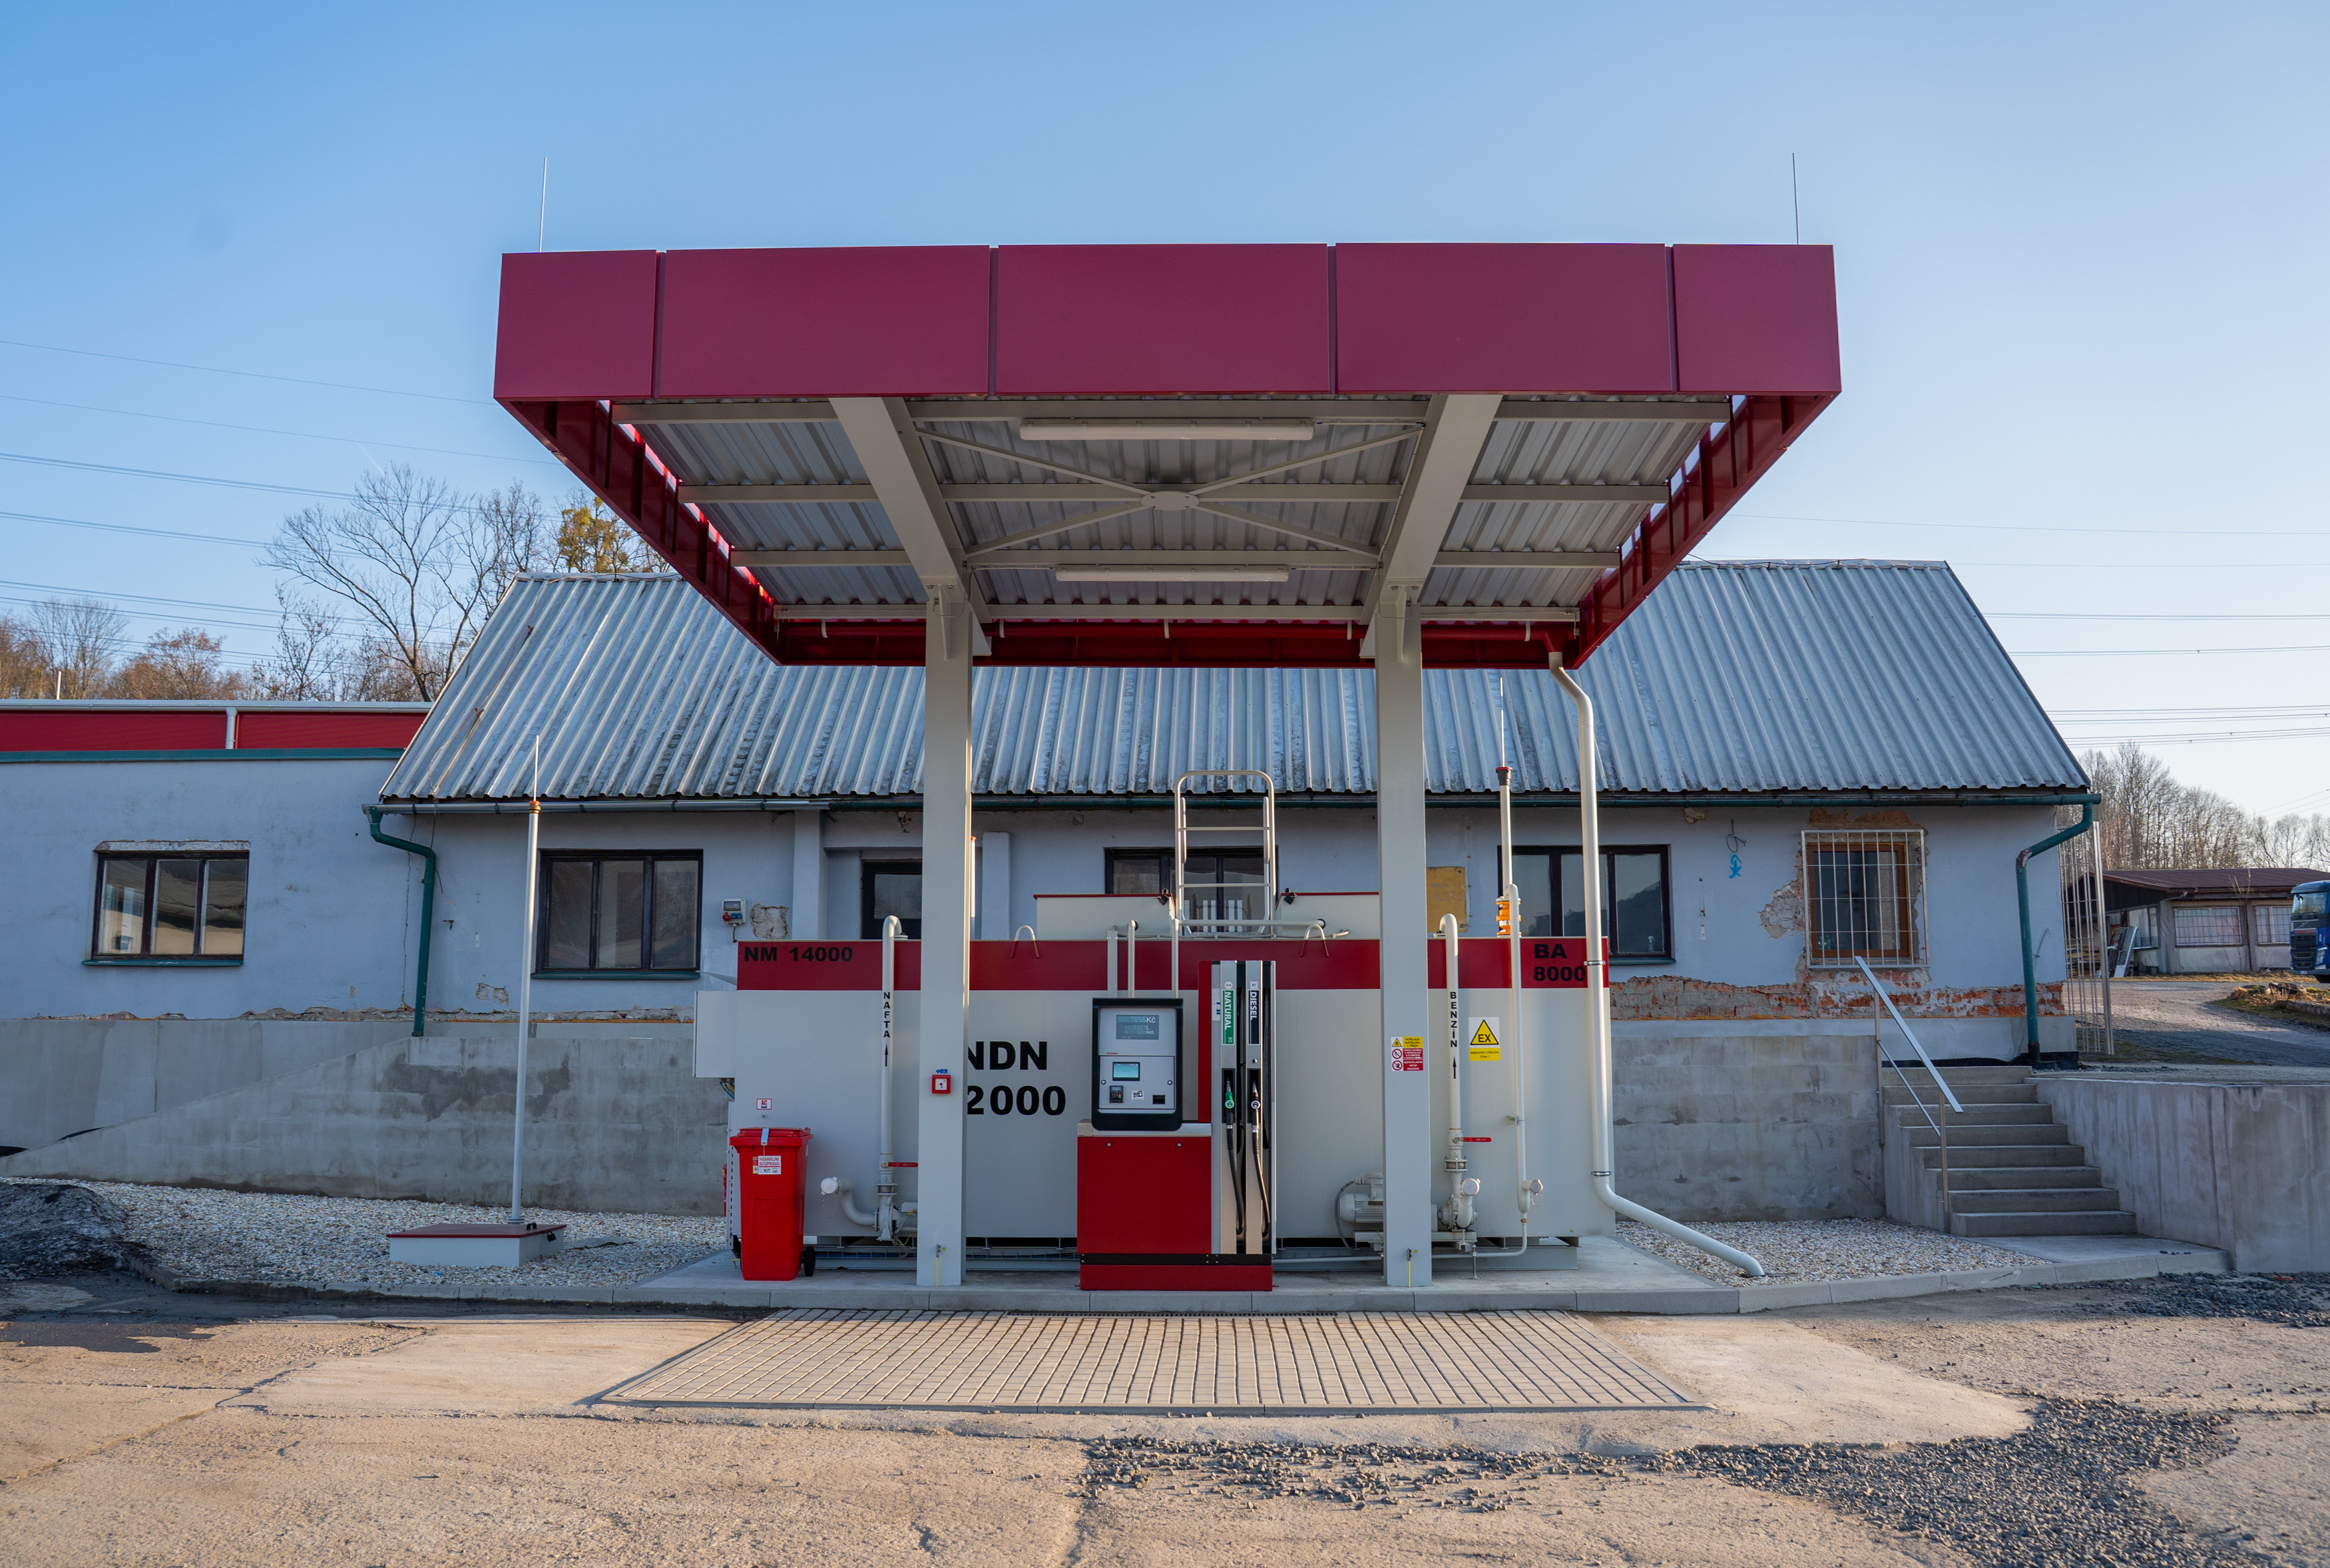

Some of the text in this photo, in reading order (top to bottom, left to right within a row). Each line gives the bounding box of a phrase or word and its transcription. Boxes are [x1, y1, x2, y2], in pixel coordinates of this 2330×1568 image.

[744, 946, 853, 962] NM 14000
[1534, 944, 1568, 958] BA
[1534, 966, 1586, 981] 8000
[1478, 1034, 1491, 1042] EX
[968, 1041, 1047, 1070] NDN
